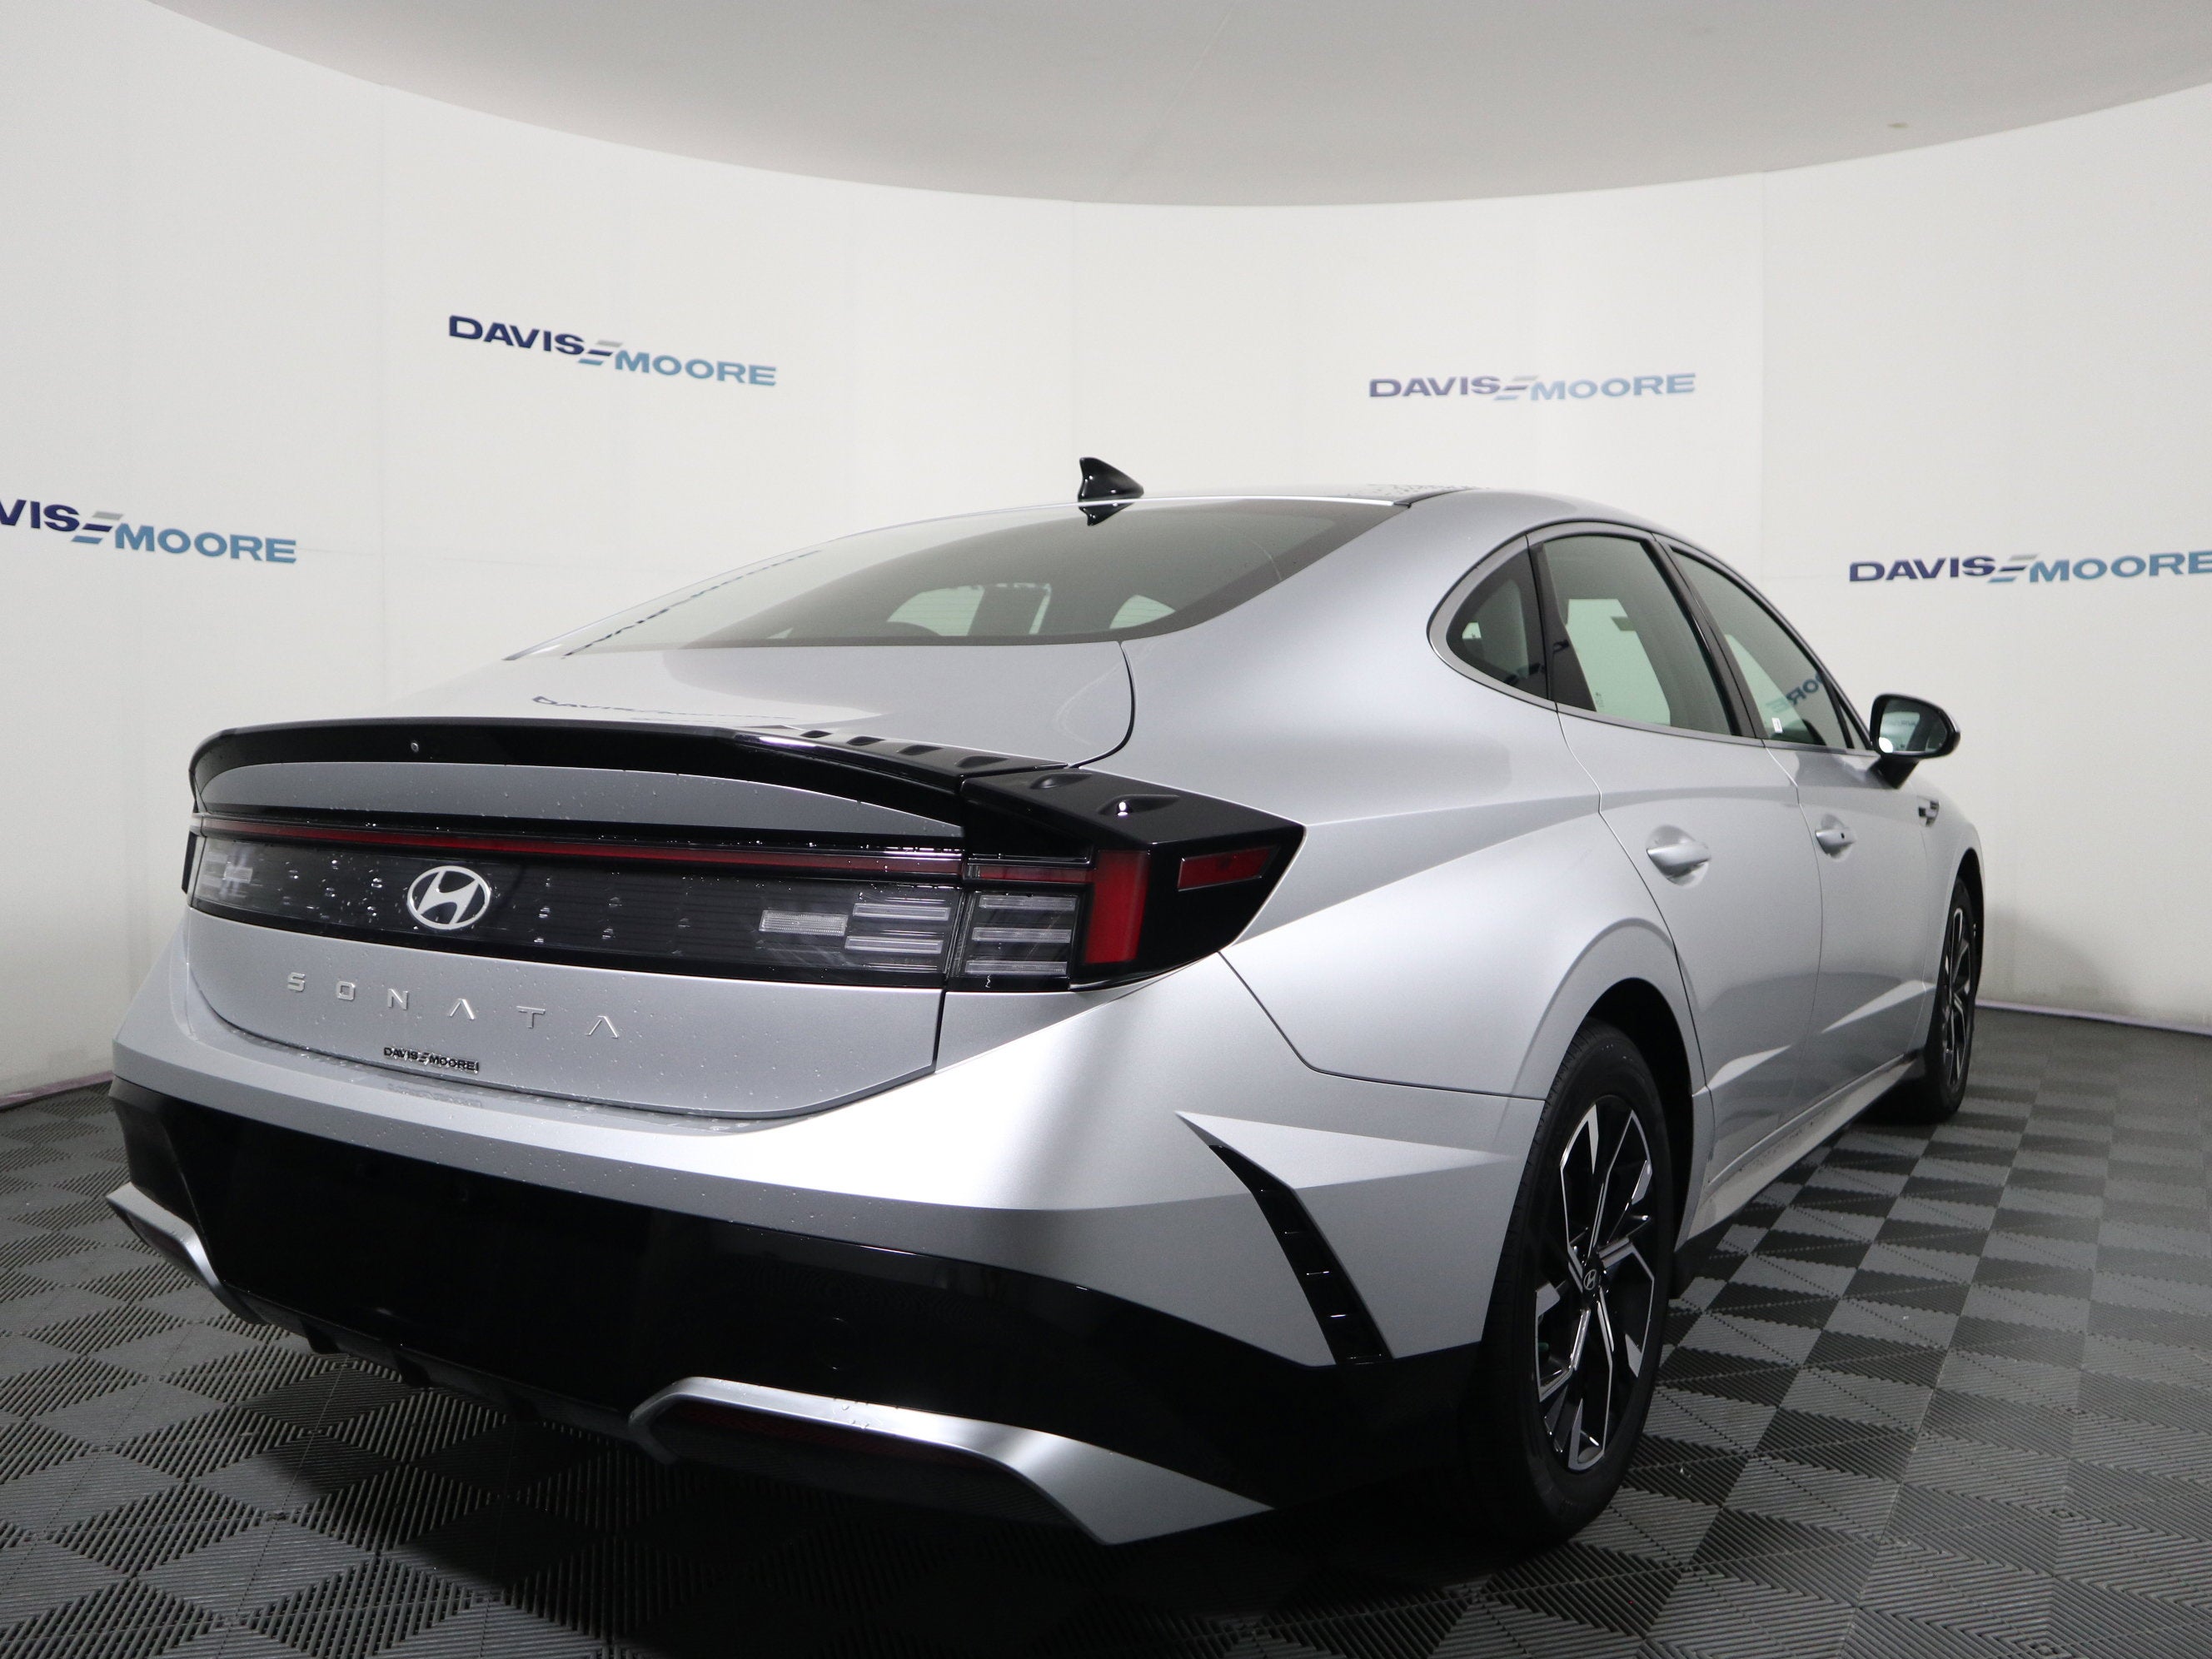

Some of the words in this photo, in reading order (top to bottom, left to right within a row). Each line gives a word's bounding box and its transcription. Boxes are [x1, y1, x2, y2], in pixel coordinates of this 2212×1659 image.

[448, 314, 586, 356] DAVIS
[614, 349, 777, 387] MOORE
[1368, 375, 1502, 399] DAVIS
[1530, 372, 1696, 401] MOORE
[114, 521, 297, 565] MOORE
[1848, 555, 1996, 584] DAVIS
[2028, 549, 2212, 585] MOORE
[286, 971, 620, 1039] SONATA
[384, 1047, 418, 1061] DAVIS
